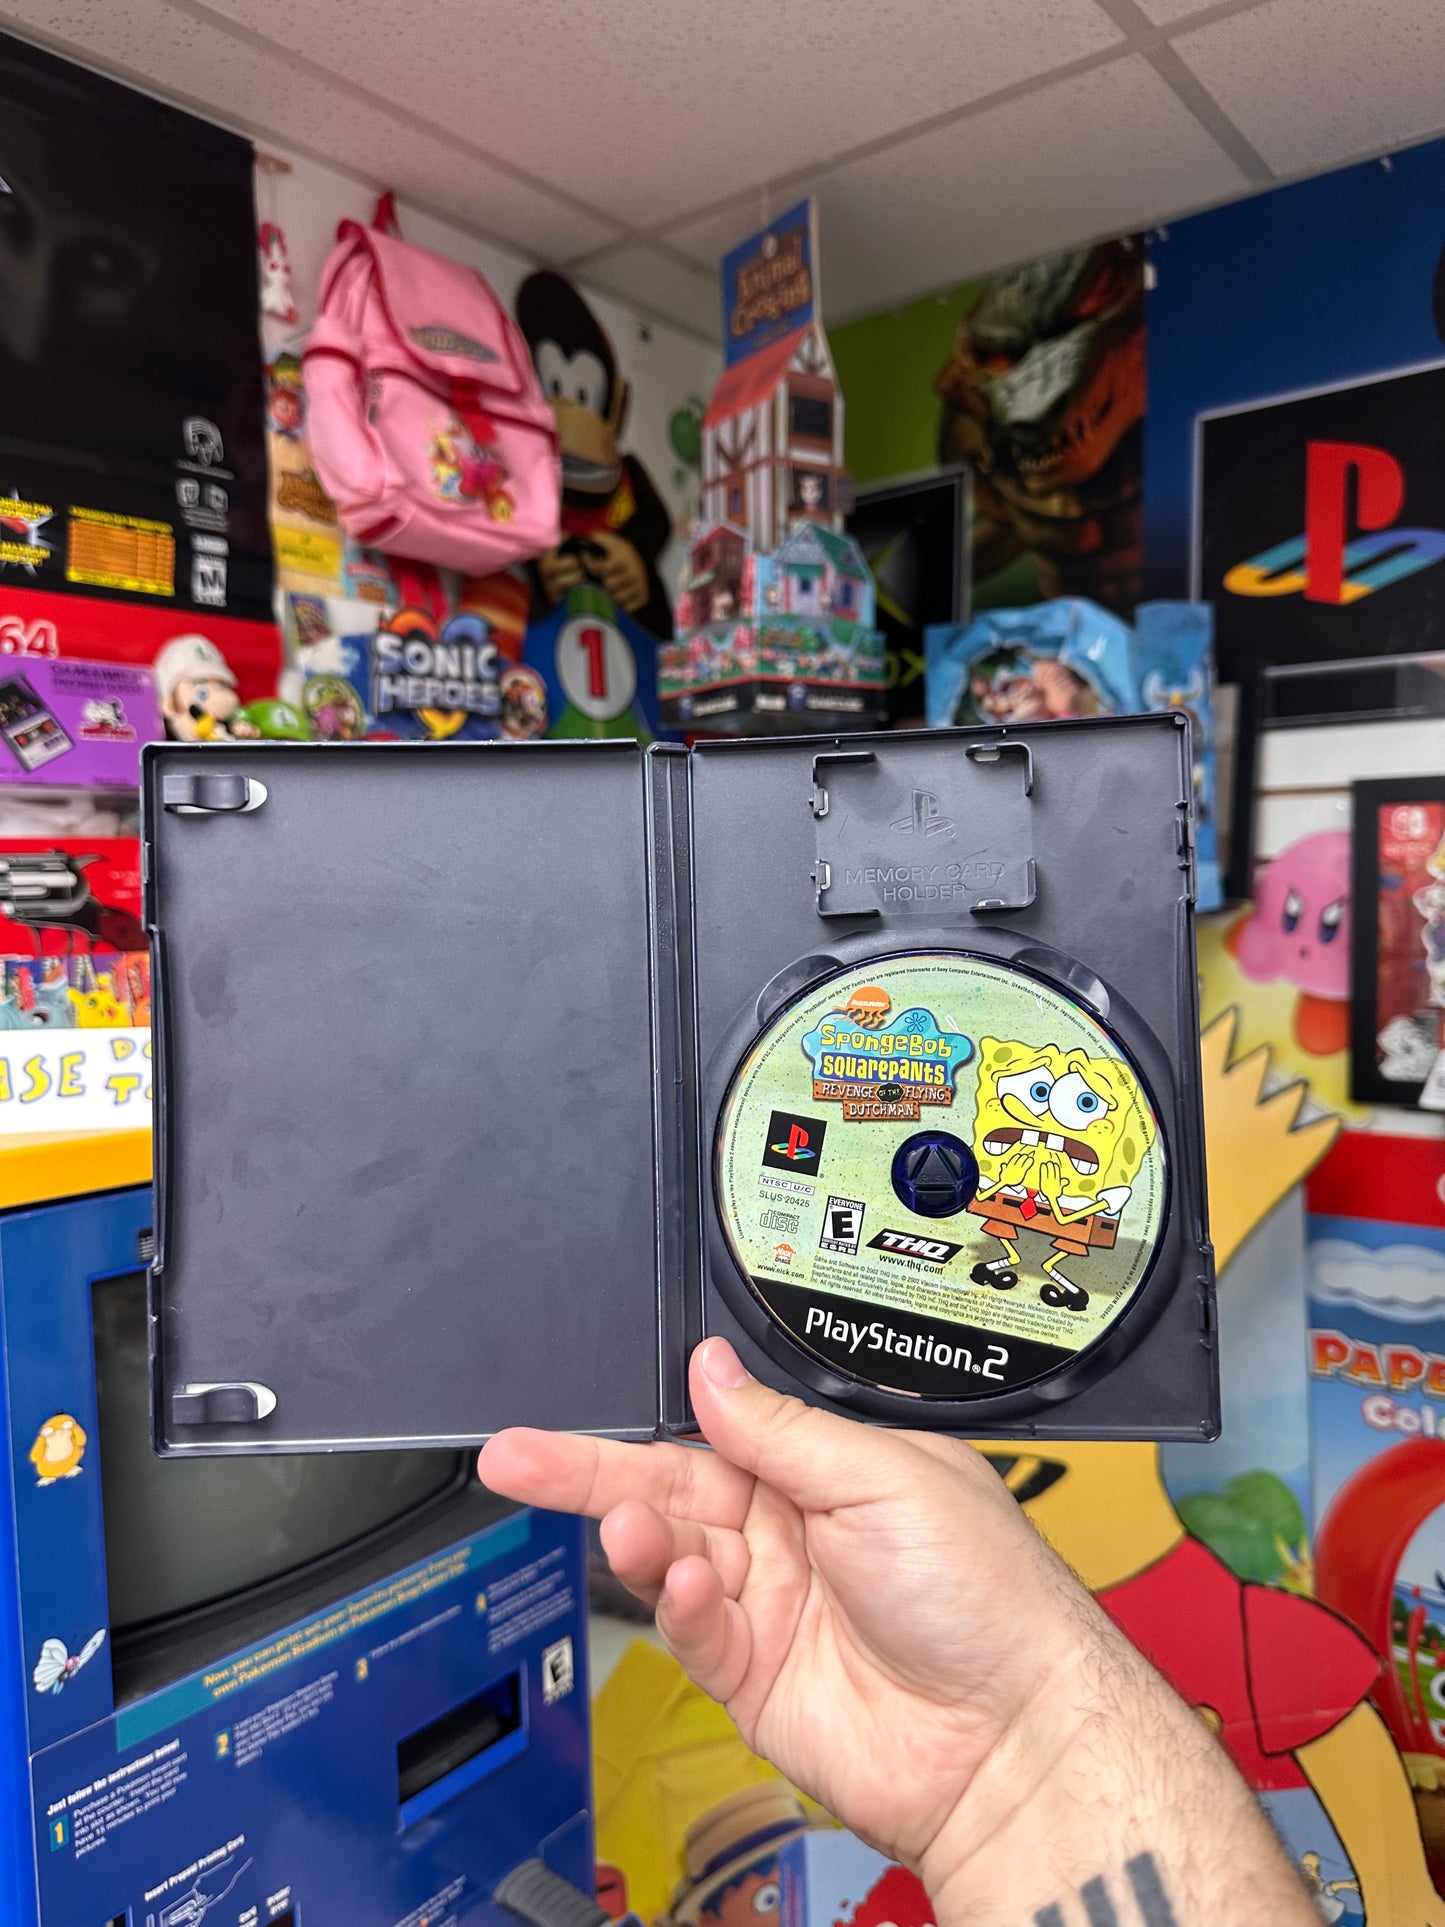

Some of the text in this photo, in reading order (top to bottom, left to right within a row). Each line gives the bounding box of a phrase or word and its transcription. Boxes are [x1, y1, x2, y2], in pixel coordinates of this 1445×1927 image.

[200, 569, 226, 589] M
[0, 615, 59, 660] 64
[376, 632, 499, 681] SONIC
[579, 628, 607, 699] 1
[376, 672, 501, 716] HEROES
[846, 862, 1006, 885] MEMORY CARD
[883, 884, 967, 902] HOLDER
[821, 1024, 953, 1058] SpongeBob
[105, 1073, 153, 1106] T
[822, 1083, 946, 1101] REVENGE OF THE FLYING
[849, 1103, 914, 1117] DUTCHMAN
[762, 1177, 812, 1193] NTSC U/C
[758, 1189, 811, 1208] SLUS 20425
[828, 1196, 864, 1211] EVERYONE
[760, 1208, 800, 1235] disc
[773, 1210, 800, 1220] COMPACT
[831, 1210, 855, 1239] E
[820, 1242, 856, 1255] ESRB
[882, 1231, 950, 1261] THQ
[757, 1263, 805, 1280] www.nick.com
[866, 1266, 878, 1275] 2002
[879, 1269, 890, 1277] THQ
[907, 1276, 920, 1284] 2002
[879, 1253, 944, 1276] www.thq.com
[805, 1307, 1010, 1381] PlayStation 2
[47, 1796, 66, 1817] Just
[67, 1783, 92, 1806] follow
[93, 1775, 106, 1793] the
[107, 1750, 153, 1785] instructions
[53, 1820, 66, 1845] 1
[144, 1880, 167, 1902] Insert
